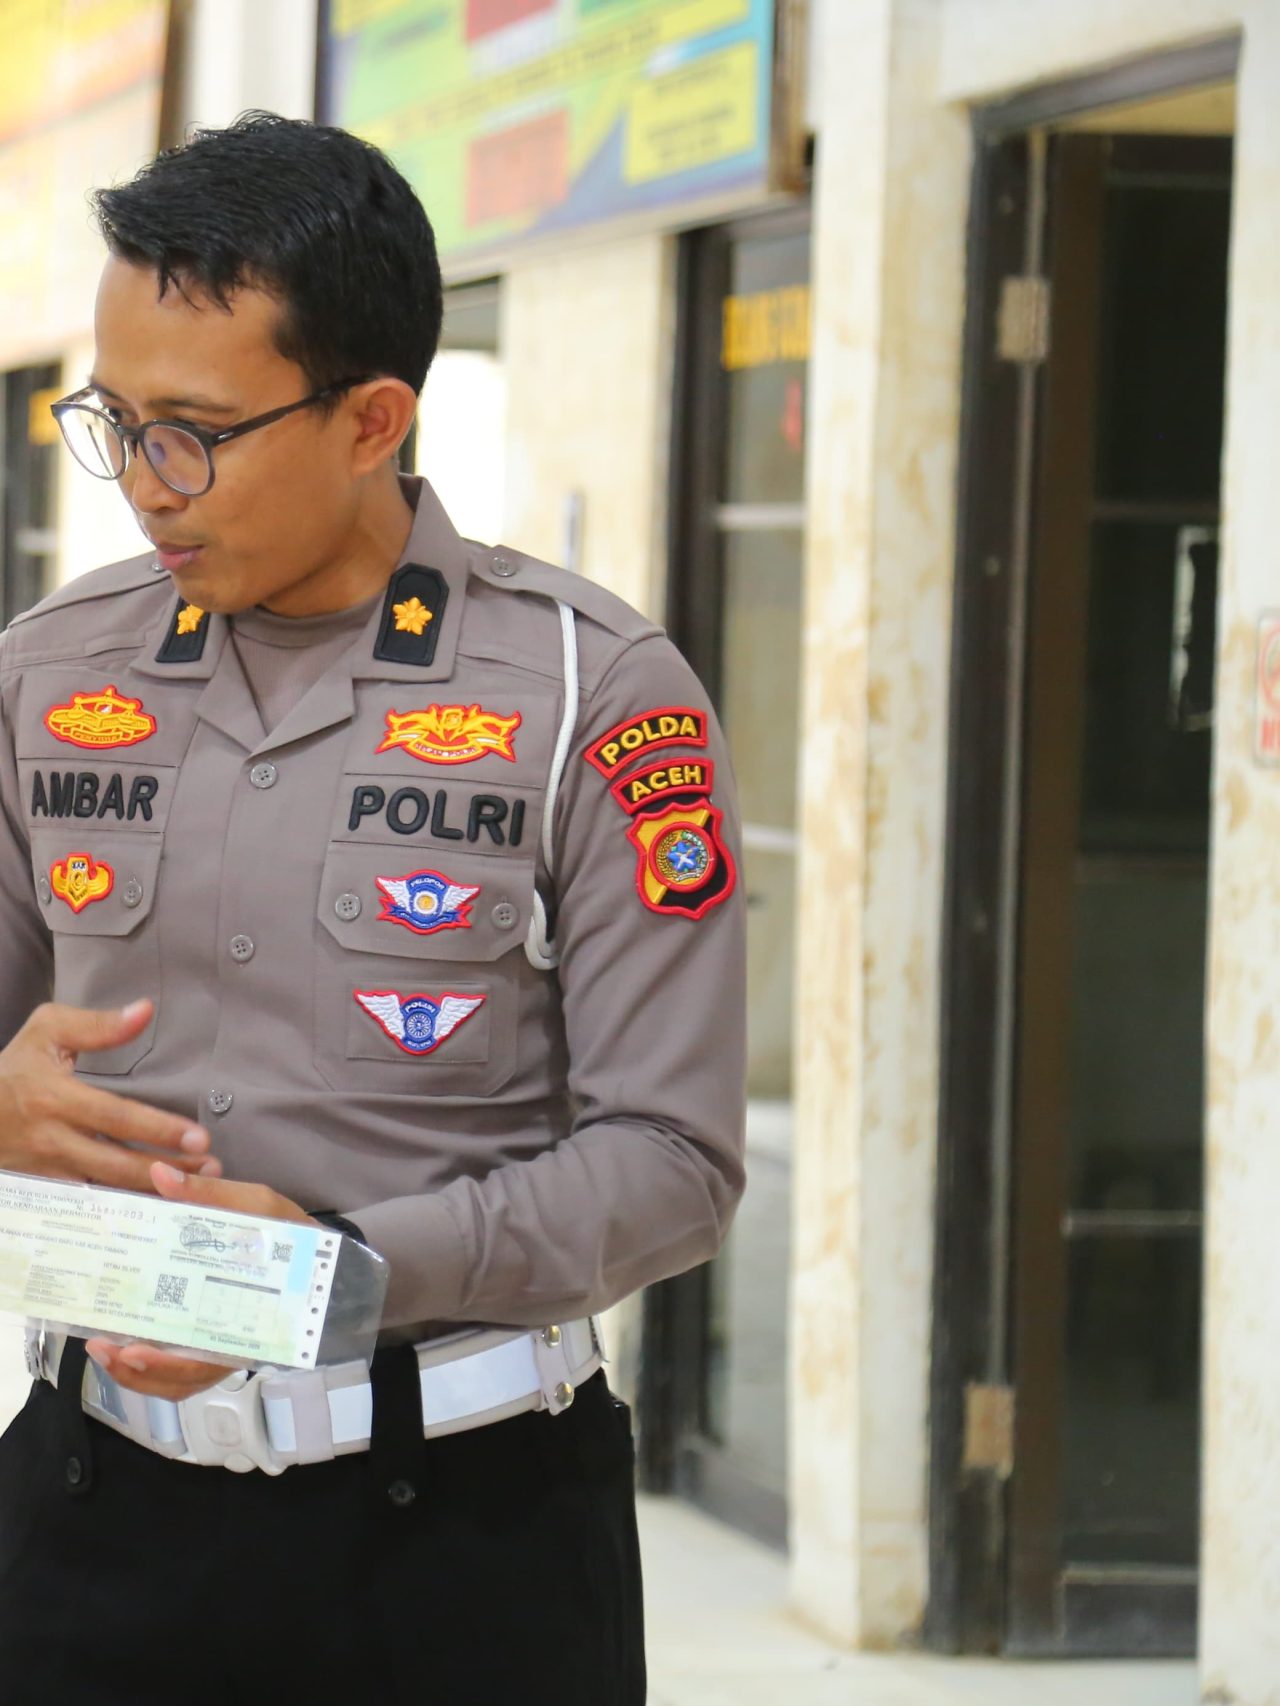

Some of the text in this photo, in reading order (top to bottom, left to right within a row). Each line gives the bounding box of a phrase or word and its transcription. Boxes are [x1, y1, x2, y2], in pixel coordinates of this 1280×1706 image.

[600, 716, 698, 765] POLDA
[31, 770, 158, 821] AMBAR
[630, 765, 702, 801] ACEH
[348, 785, 526, 846] POLRI
